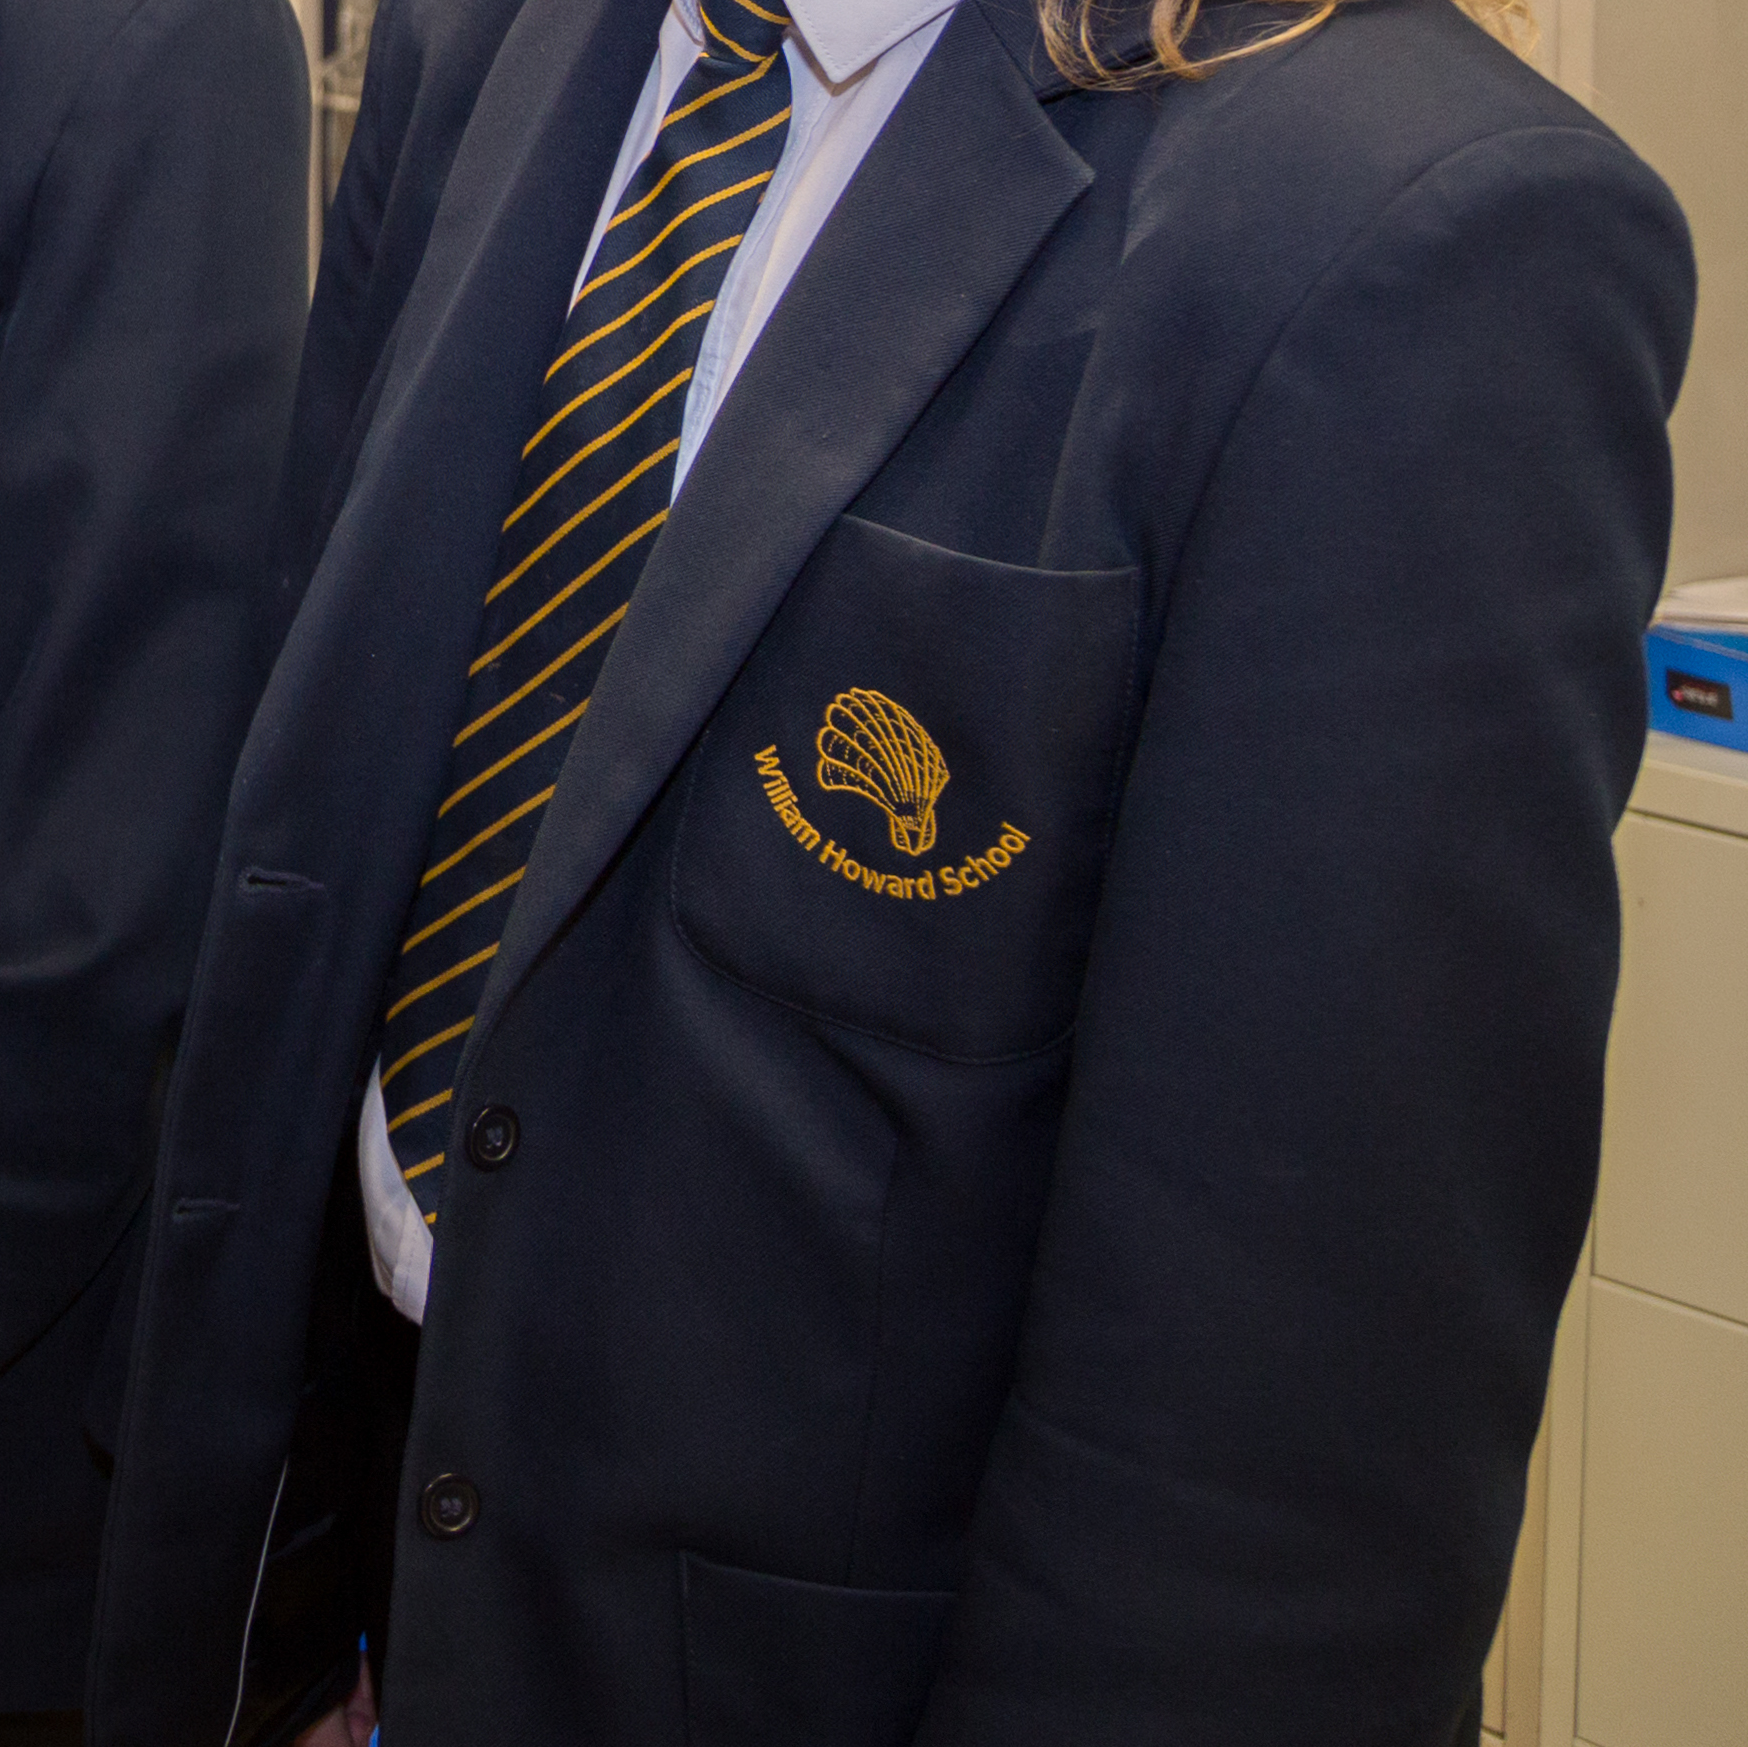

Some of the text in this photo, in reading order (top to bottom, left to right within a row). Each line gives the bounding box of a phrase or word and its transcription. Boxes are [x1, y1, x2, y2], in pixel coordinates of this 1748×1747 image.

[754, 743, 1032, 901] William Howard School
